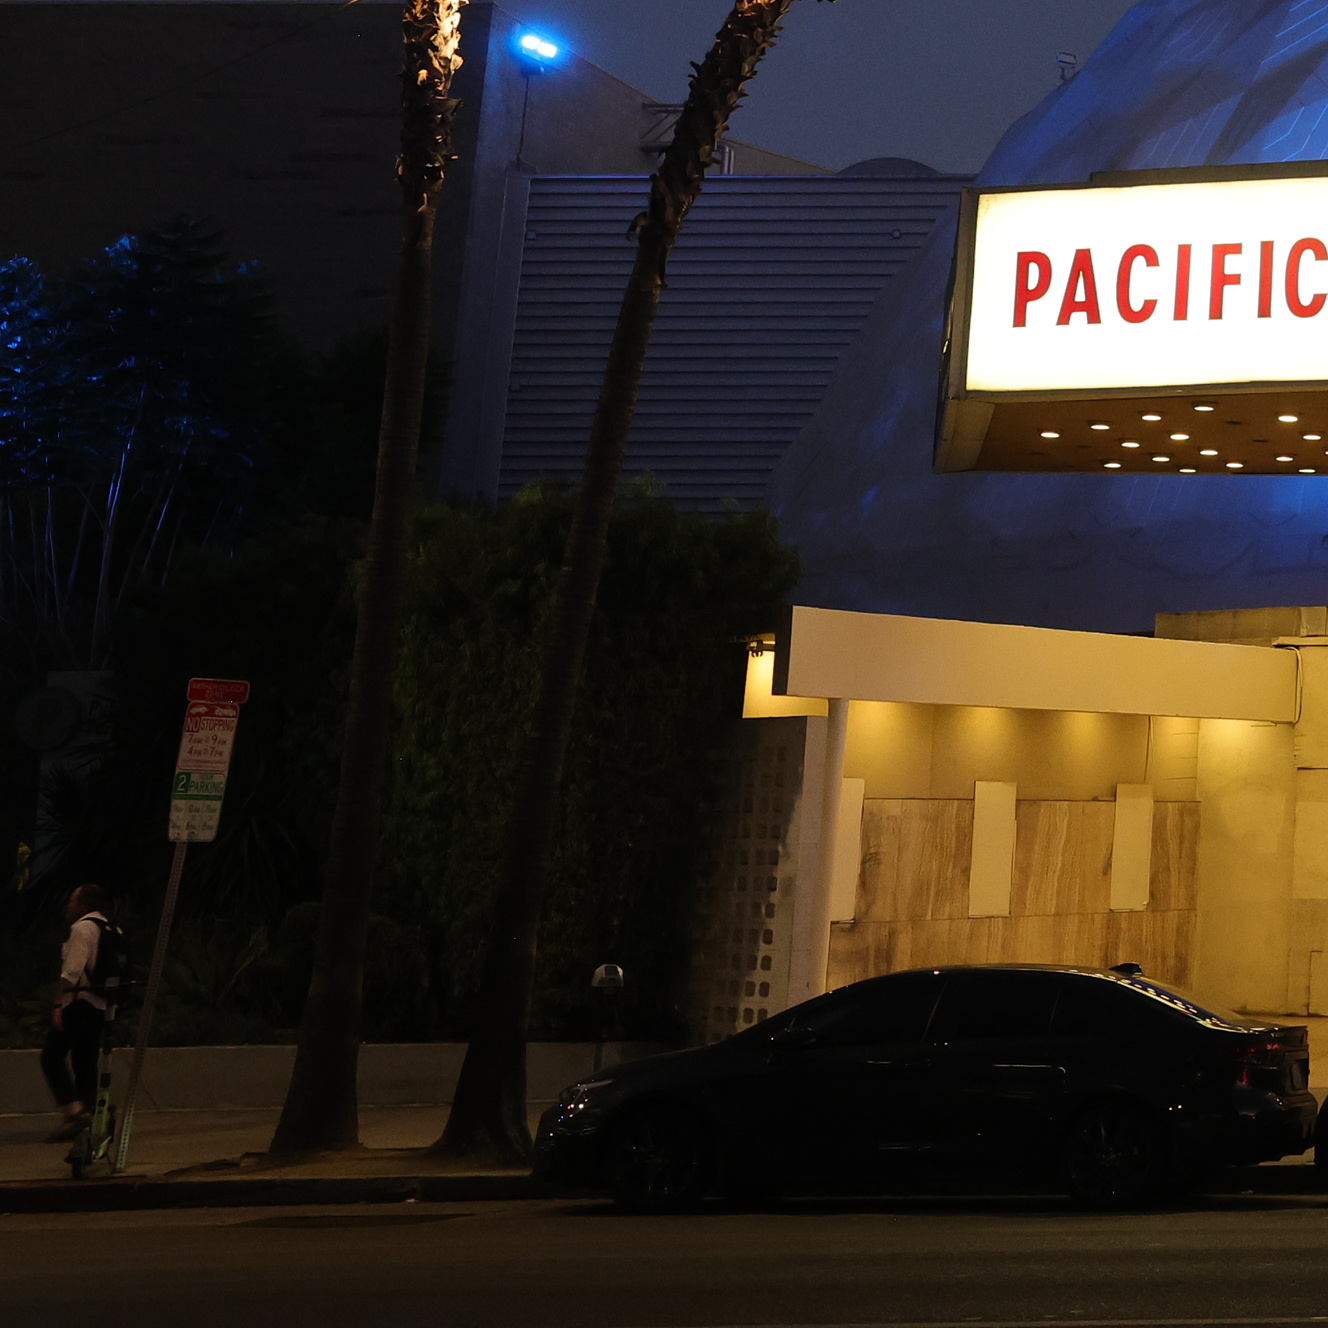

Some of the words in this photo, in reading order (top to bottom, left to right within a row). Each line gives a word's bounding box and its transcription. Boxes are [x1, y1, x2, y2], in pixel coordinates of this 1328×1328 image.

[185, 717, 200, 731] NO
[200, 718, 237, 732] STOPPING
[177, 774, 187, 791] 2
[189, 780, 224, 793] PARKING
